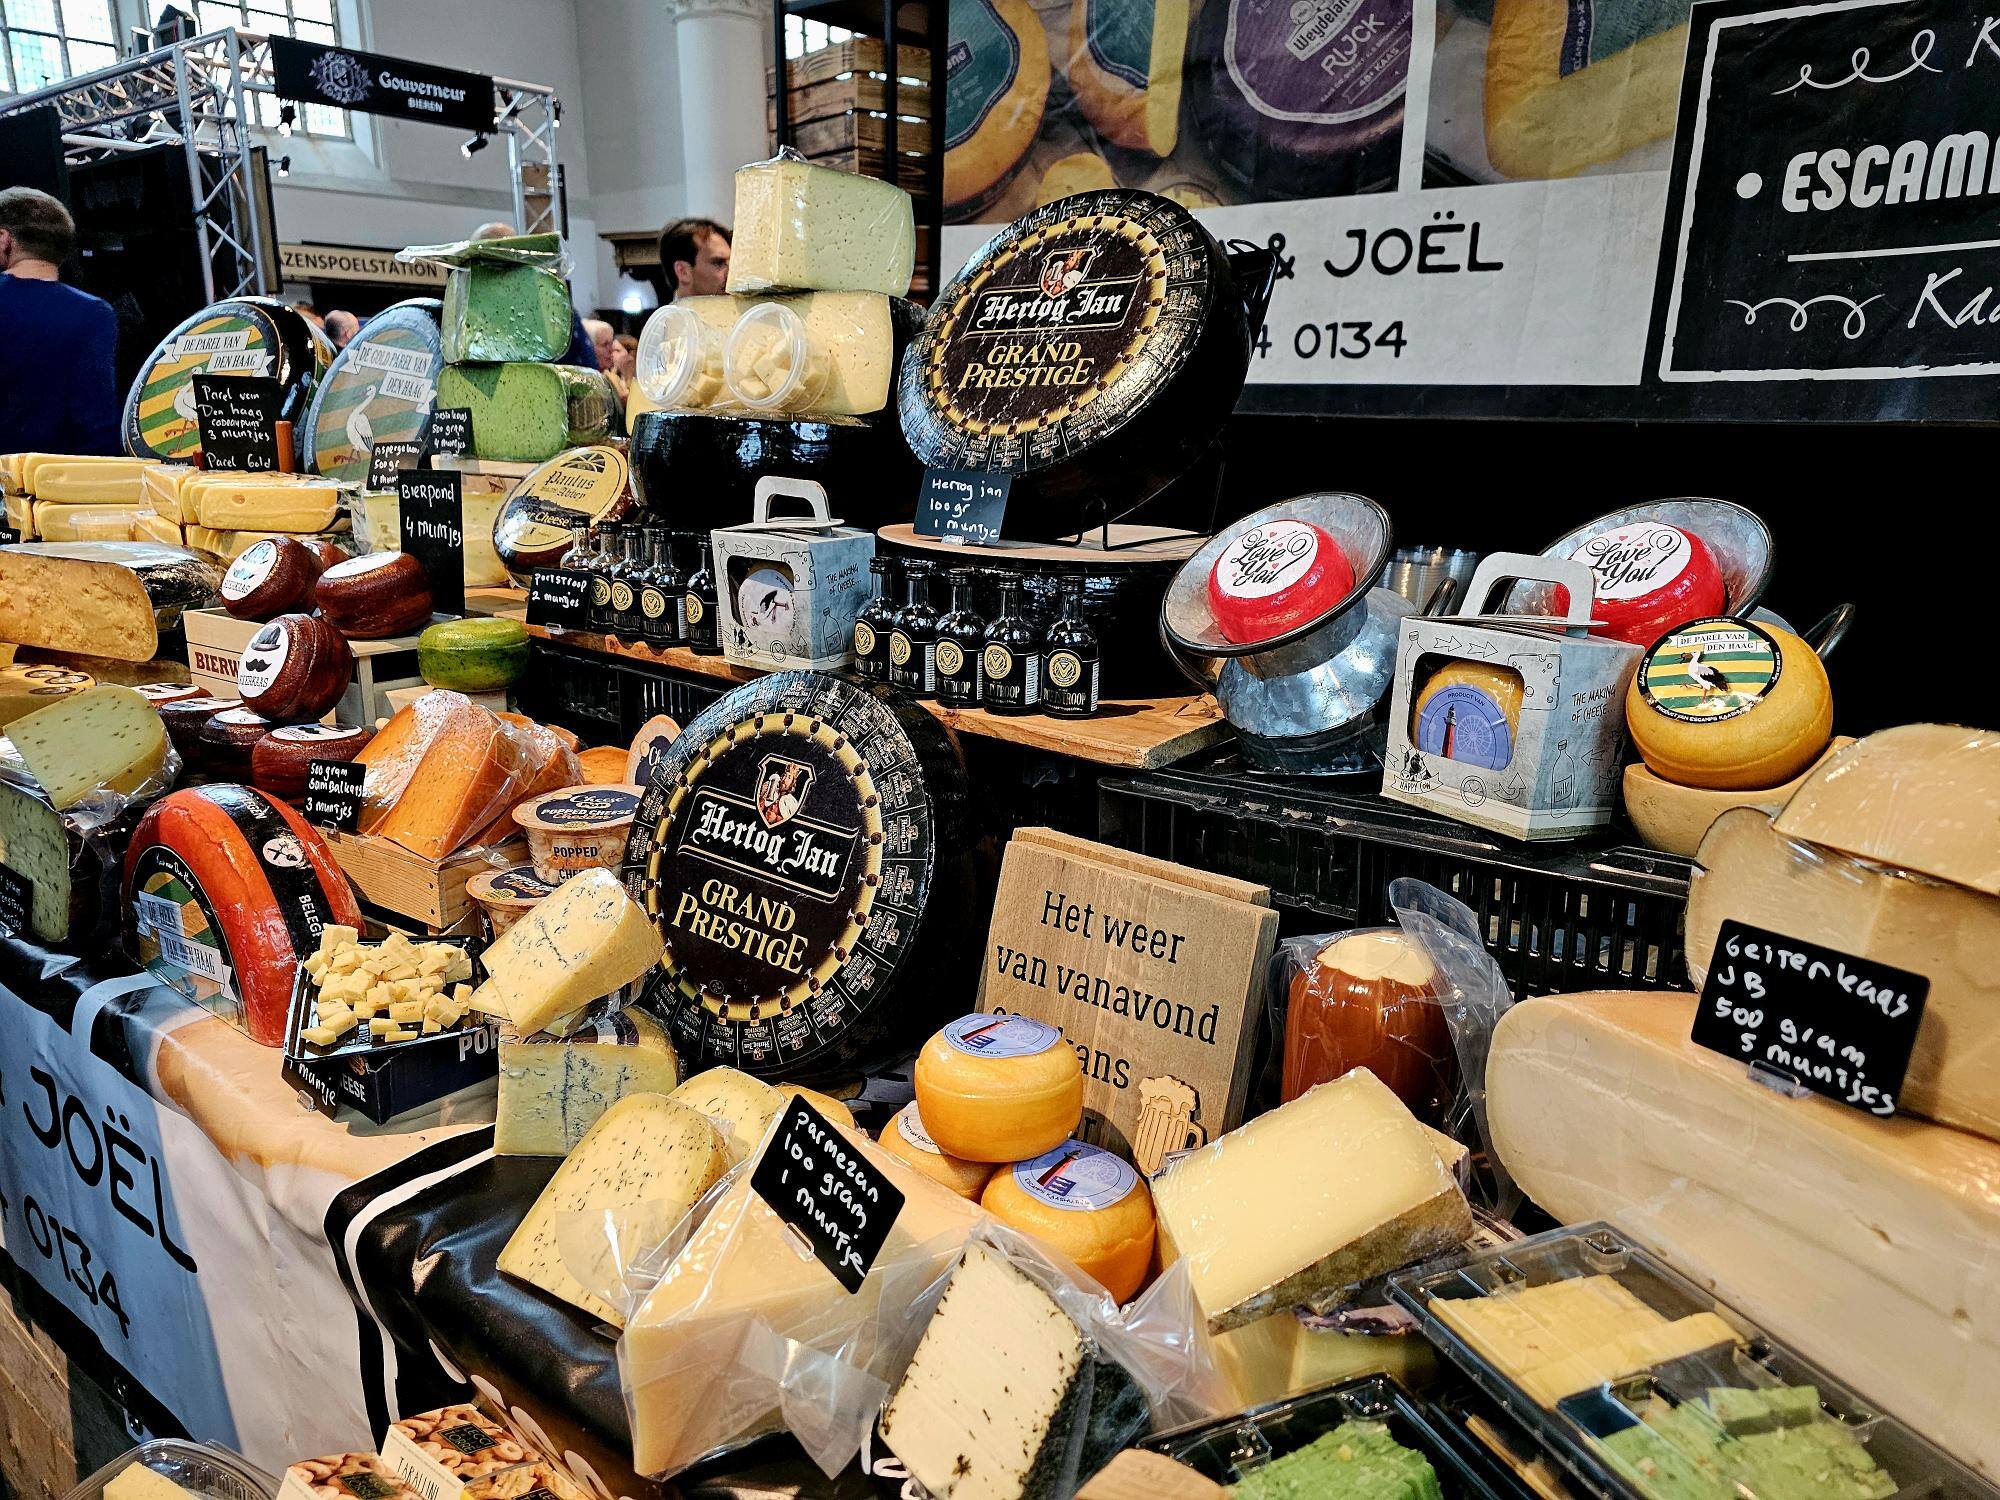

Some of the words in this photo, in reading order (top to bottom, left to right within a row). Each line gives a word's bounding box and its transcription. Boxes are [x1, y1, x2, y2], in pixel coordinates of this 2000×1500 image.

[1320, 13, 1384, 76] RIJCK
[1375, 47, 1400, 71] KAAS
[379, 71, 466, 102] Gouverneur
[407, 97, 443, 113] BIEREN
[1323, 210, 1504, 278] JOËL
[281, 251, 438, 278] ZENSPOELSTATION
[977, 293, 1068, 329] Hertog
[1066, 288, 1124, 323] Jan
[183, 338, 194, 352] DE
[195, 336, 221, 351] PAREL
[223, 335, 241, 349] VAN
[1294, 320, 1408, 359] 0134
[214, 354, 232, 369] DEN
[233, 353, 258, 368] HAAG
[359, 346, 372, 363] DE
[390, 352, 413, 371] PAREL
[413, 356, 430, 374] VAN
[988, 342, 1082, 365] GRAND
[959, 357, 1095, 390] PRESTIGE
[202, 385, 233, 401] Parel
[386, 377, 402, 395] DEN
[401, 381, 425, 399] HAAG
[198, 403, 224, 418] Den
[230, 403, 264, 421] haag
[208, 430, 217, 441] 3
[206, 452, 237, 469] Parel
[247, 453, 271, 468] Gold
[545, 470, 598, 490] Paulus
[931, 478, 974, 501] Hertog
[980, 480, 1002, 498] jan
[556, 487, 586, 504] Abbey
[535, 511, 570, 527] Cheese
[929, 498, 950, 511] 100
[952, 503, 971, 518] gr
[406, 516, 414, 538] 4
[418, 520, 462, 548] muntjes
[1230, 529, 1287, 564] Love
[1586, 536, 1652, 570] Love
[826, 573, 838, 585] THE
[1600, 561, 1658, 590] You
[531, 591, 541, 601] 2
[544, 591, 580, 609] muntjes
[829, 585, 837, 596] OF
[1680, 637, 1692, 645] DE
[1694, 634, 1725, 645] PAREL
[1726, 633, 1746, 642] VAN
[1706, 644, 1727, 652] DEN
[1728, 642, 1754, 651] HAAG
[1447, 692, 1474, 700] PRODUCT
[1474, 697, 1485, 707] VAN
[1572, 691, 1586, 707] THE
[1587, 684, 1616, 703] MAKING
[1571, 708, 1582, 723] OF
[1656, 704, 1677, 719] PRODUCT
[323, 765, 348, 782] gram
[1399, 781, 1418, 792] HAPPY
[305, 797, 313, 812] 3
[315, 801, 352, 821] muntjes
[692, 800, 785, 868] Hertog
[783, 829, 840, 879] Jan
[553, 846, 598, 858] POPPED
[701, 878, 796, 932] GRAND
[671, 892, 808, 974] PRESTIGE
[1040, 890, 1094, 939] Het
[1103, 914, 1186, 964] weer
[997, 945, 1048, 989] van
[1056, 964, 1221, 1046] vanavond
[1715, 996, 1764, 1029] 500
[1780, 1018, 1866, 1068] gram
[298, 1063, 337, 1107] muntje
[1740, 1033, 1757, 1052] 5
[1766, 1044, 1896, 1116] muntjes
[22, 1065, 198, 1274] JOËL
[785, 1132, 814, 1171] 100
[820, 1172, 867, 1230] gram
[1024, 1178, 1046, 1196] ESCAMPS
[781, 1168, 789, 1185] 1
[796, 1187, 866, 1278] muntje
[23, 1194, 131, 1340] 0134
